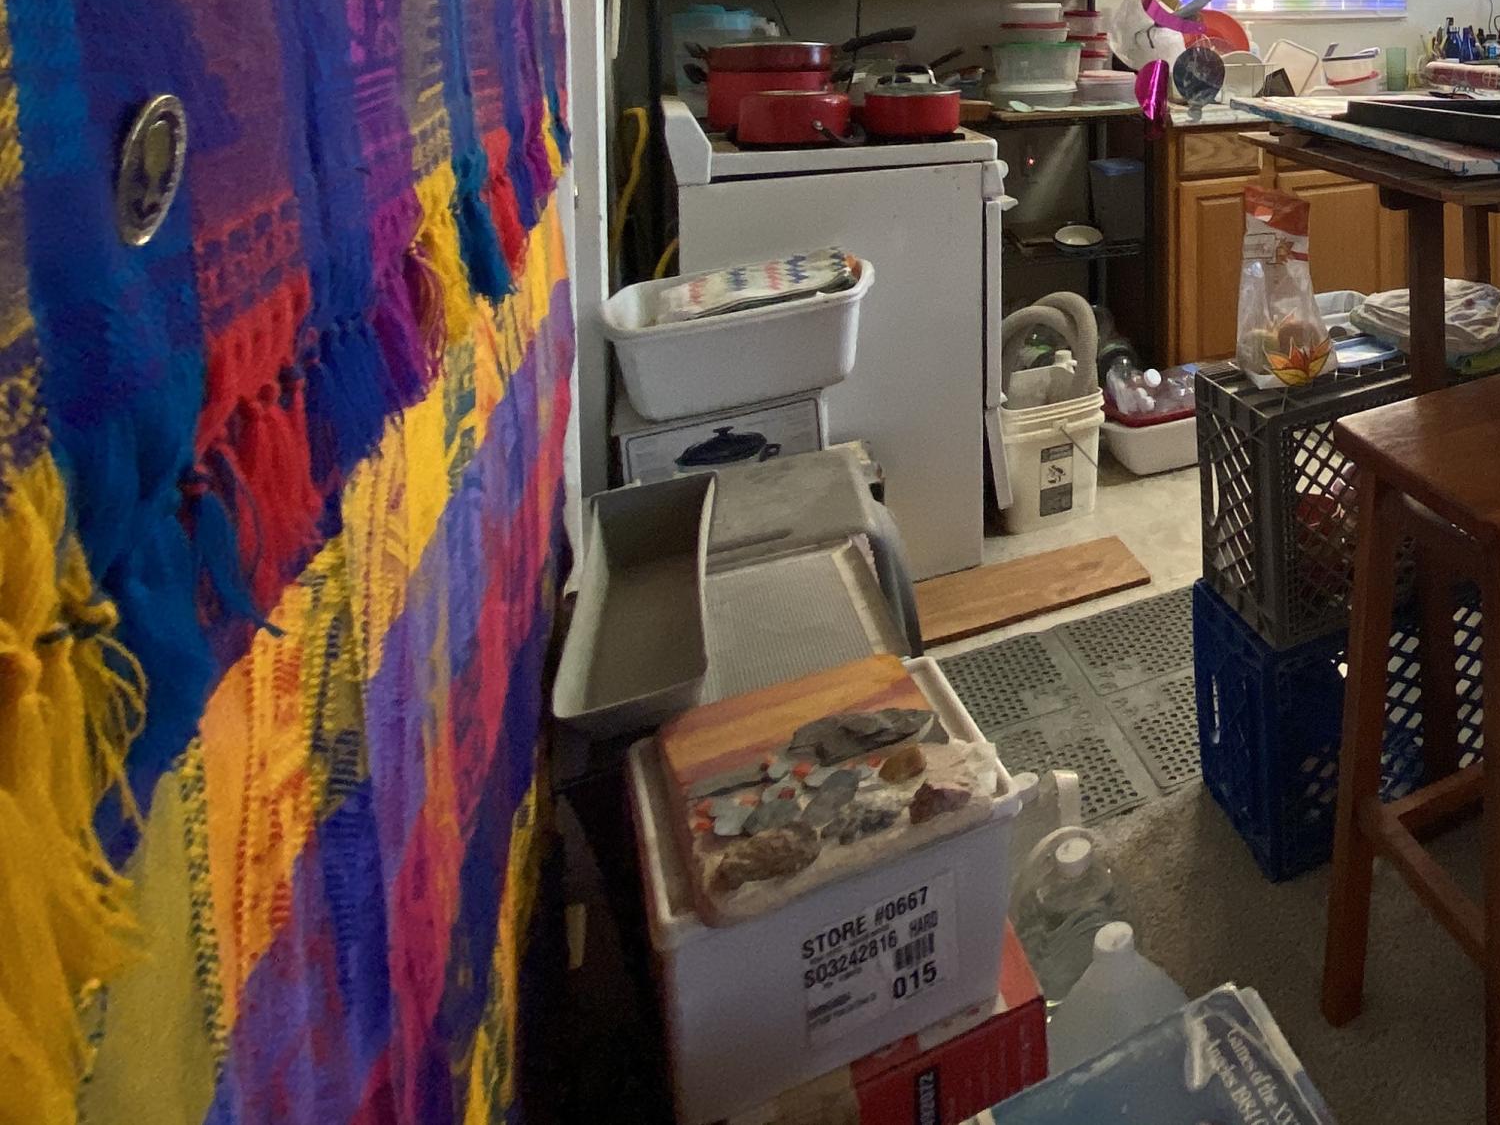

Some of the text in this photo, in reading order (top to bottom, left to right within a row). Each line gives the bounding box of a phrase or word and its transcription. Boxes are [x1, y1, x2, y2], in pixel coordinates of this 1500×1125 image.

[801, 915, 867, 960] STORE
[874, 885, 929, 926] #0667
[893, 960, 937, 999] 015
[1231, 1085, 1263, 1124] 1984
